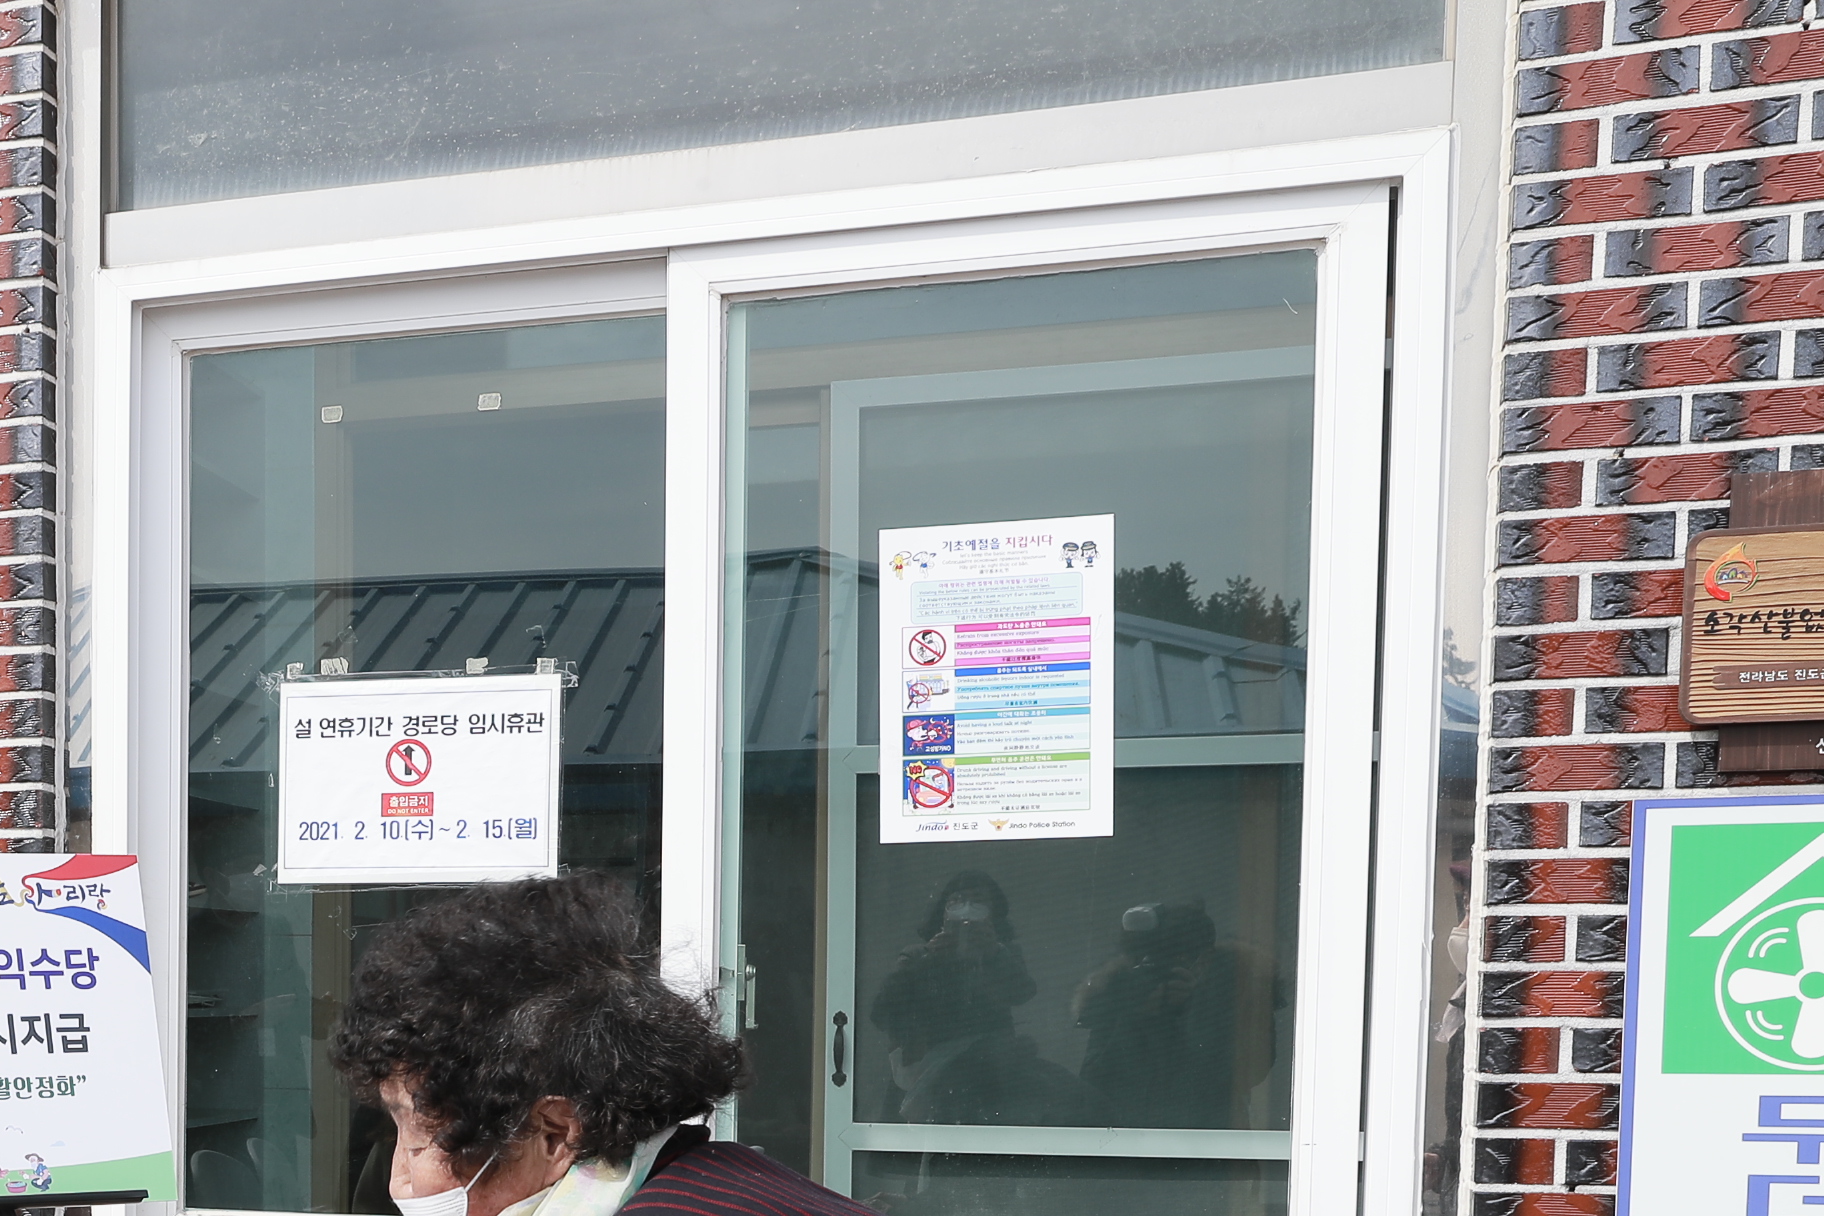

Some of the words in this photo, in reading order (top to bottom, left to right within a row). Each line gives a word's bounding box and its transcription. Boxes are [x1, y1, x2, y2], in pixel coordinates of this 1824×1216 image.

[942, 538, 1000, 552] 기초예절을
[1005, 534, 1053, 548] 지킵시다
[1739, 670, 1789, 683] 전라남도
[294, 718, 312, 739] 설
[319, 716, 393, 739] 연휴기간
[402, 714, 459, 737] 경로당
[468, 712, 545, 735] 임시휴관
[389, 795, 429, 807] 출입금지
[299, 821, 344, 841] 2021.
[354, 821, 368, 841] 2.
[483, 817, 538, 841] 15.(월)
